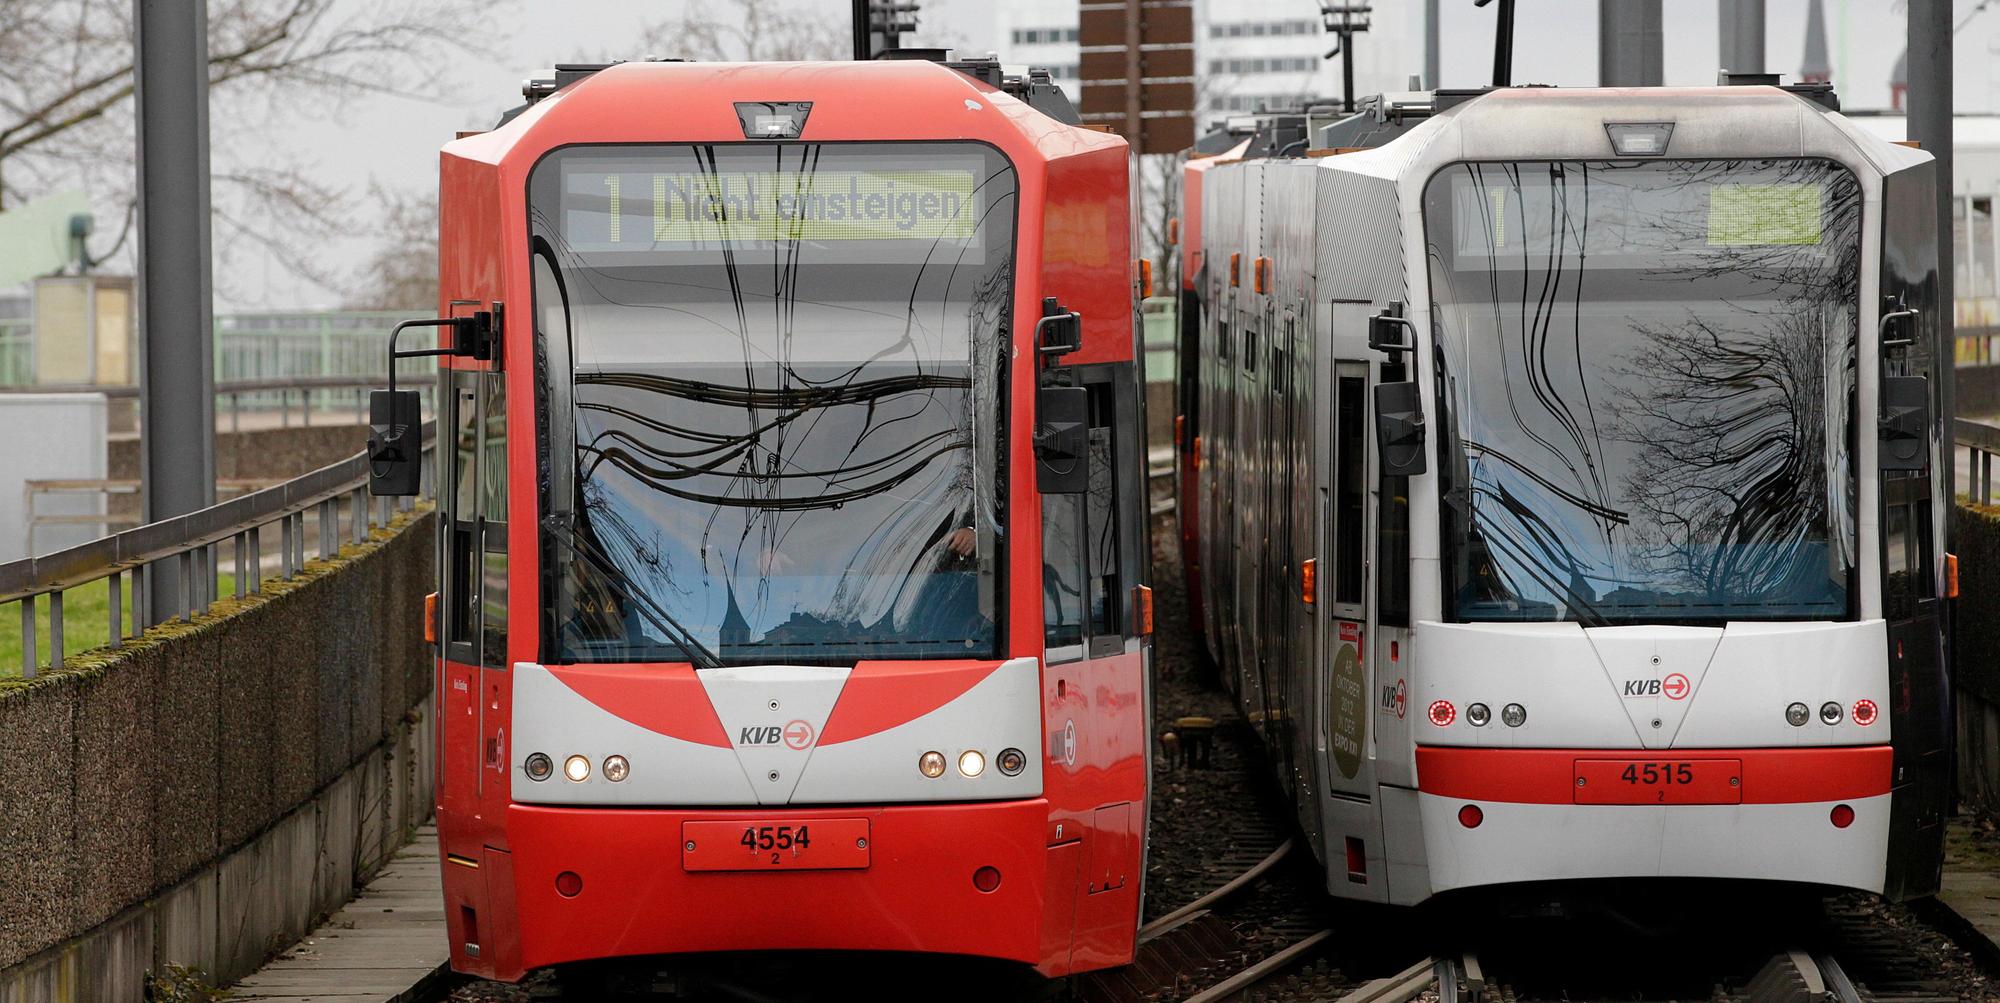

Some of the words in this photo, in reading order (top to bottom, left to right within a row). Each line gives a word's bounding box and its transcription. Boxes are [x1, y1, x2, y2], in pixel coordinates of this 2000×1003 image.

[604, 174, 620, 243] 1
[663, 175, 761, 223] Nicht
[776, 174, 961, 232] einsteigen
[1490, 190, 1504, 247] 1
[1336, 673, 1361, 698] OKTOBER
[1382, 685, 1396, 708] KVB
[1624, 679, 1661, 696] KVB
[740, 726, 782, 745] KVB
[1621, 763, 1693, 785] 4515
[1657, 790, 1664, 802] 2
[740, 825, 810, 851] 4554
[771, 853, 780, 864] 2
